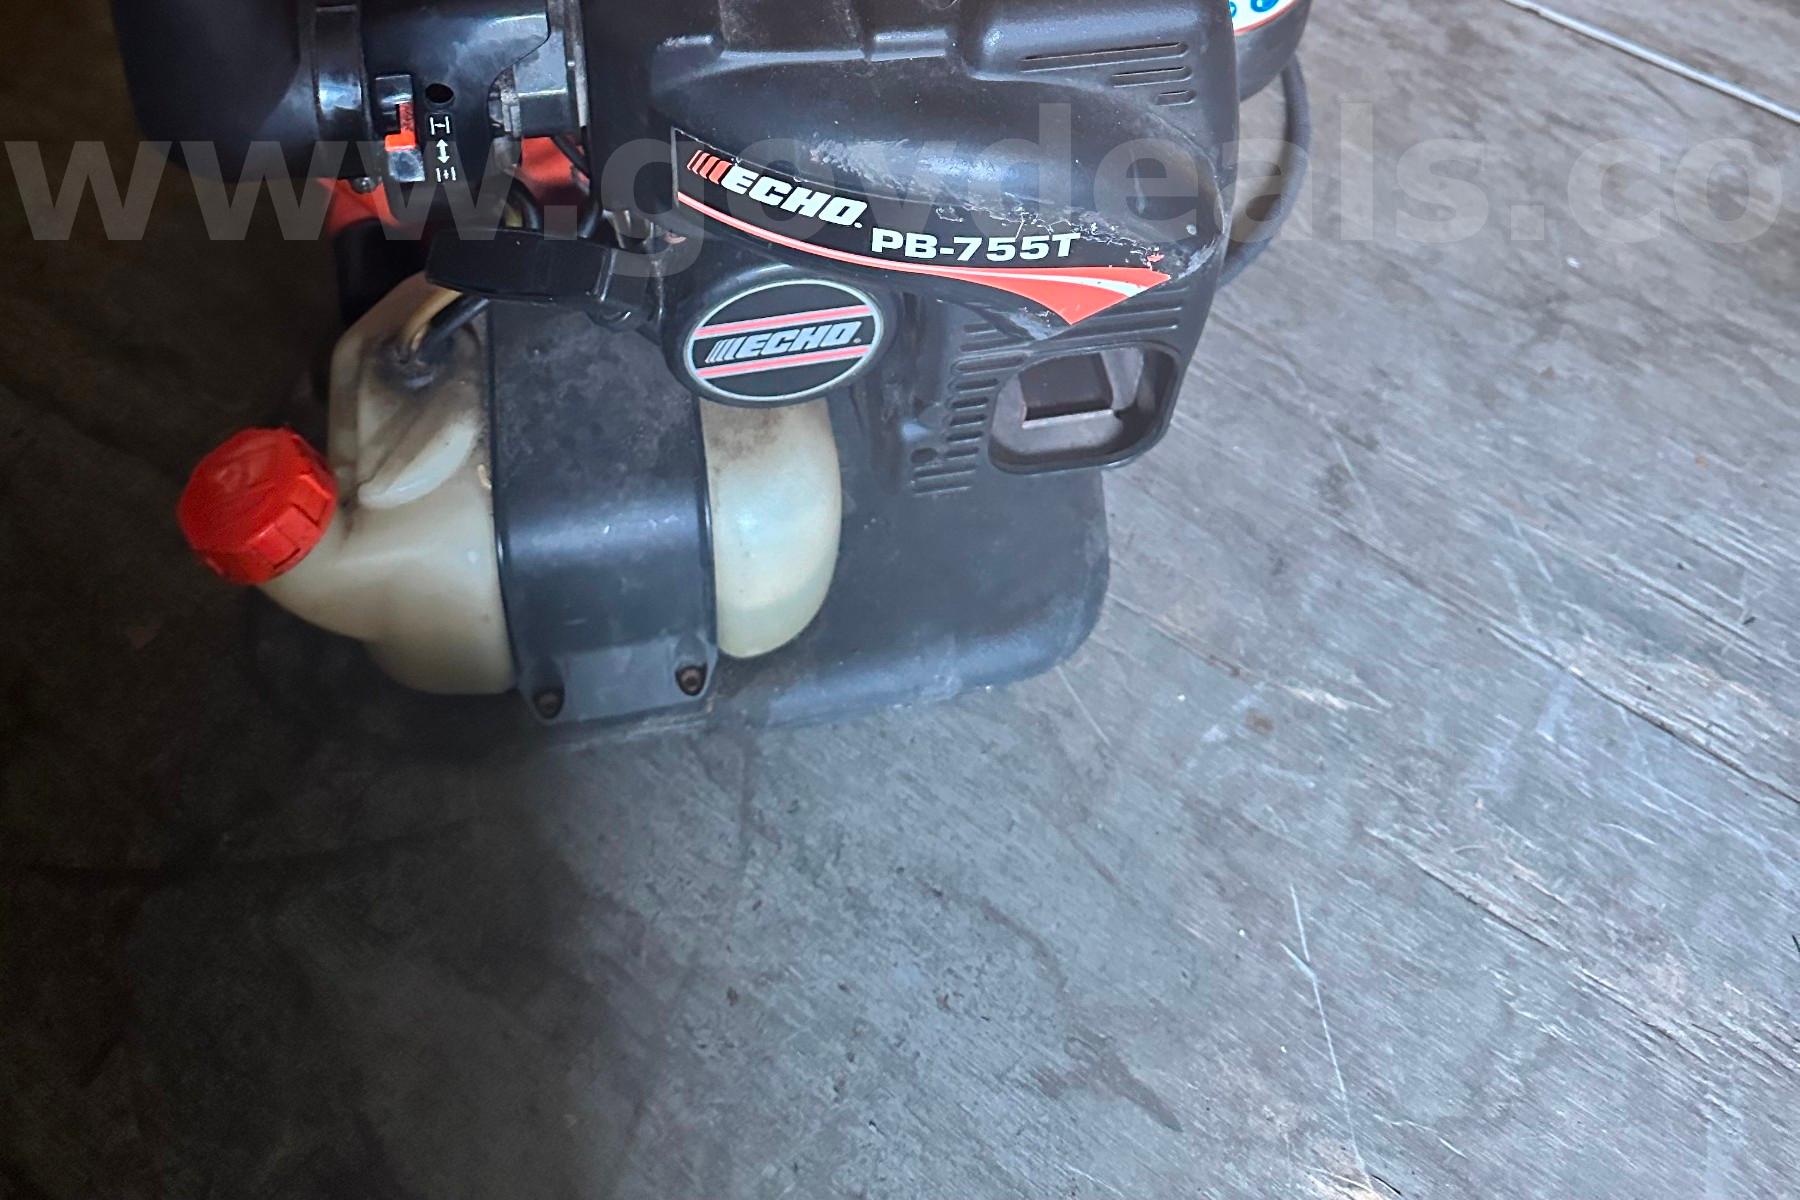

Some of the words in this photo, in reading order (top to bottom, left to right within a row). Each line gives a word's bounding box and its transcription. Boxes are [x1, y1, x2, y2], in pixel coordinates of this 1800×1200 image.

[721, 164, 868, 227] ECHO
[871, 227, 1081, 262] PB-755T
[734, 321, 862, 359] ECHO
